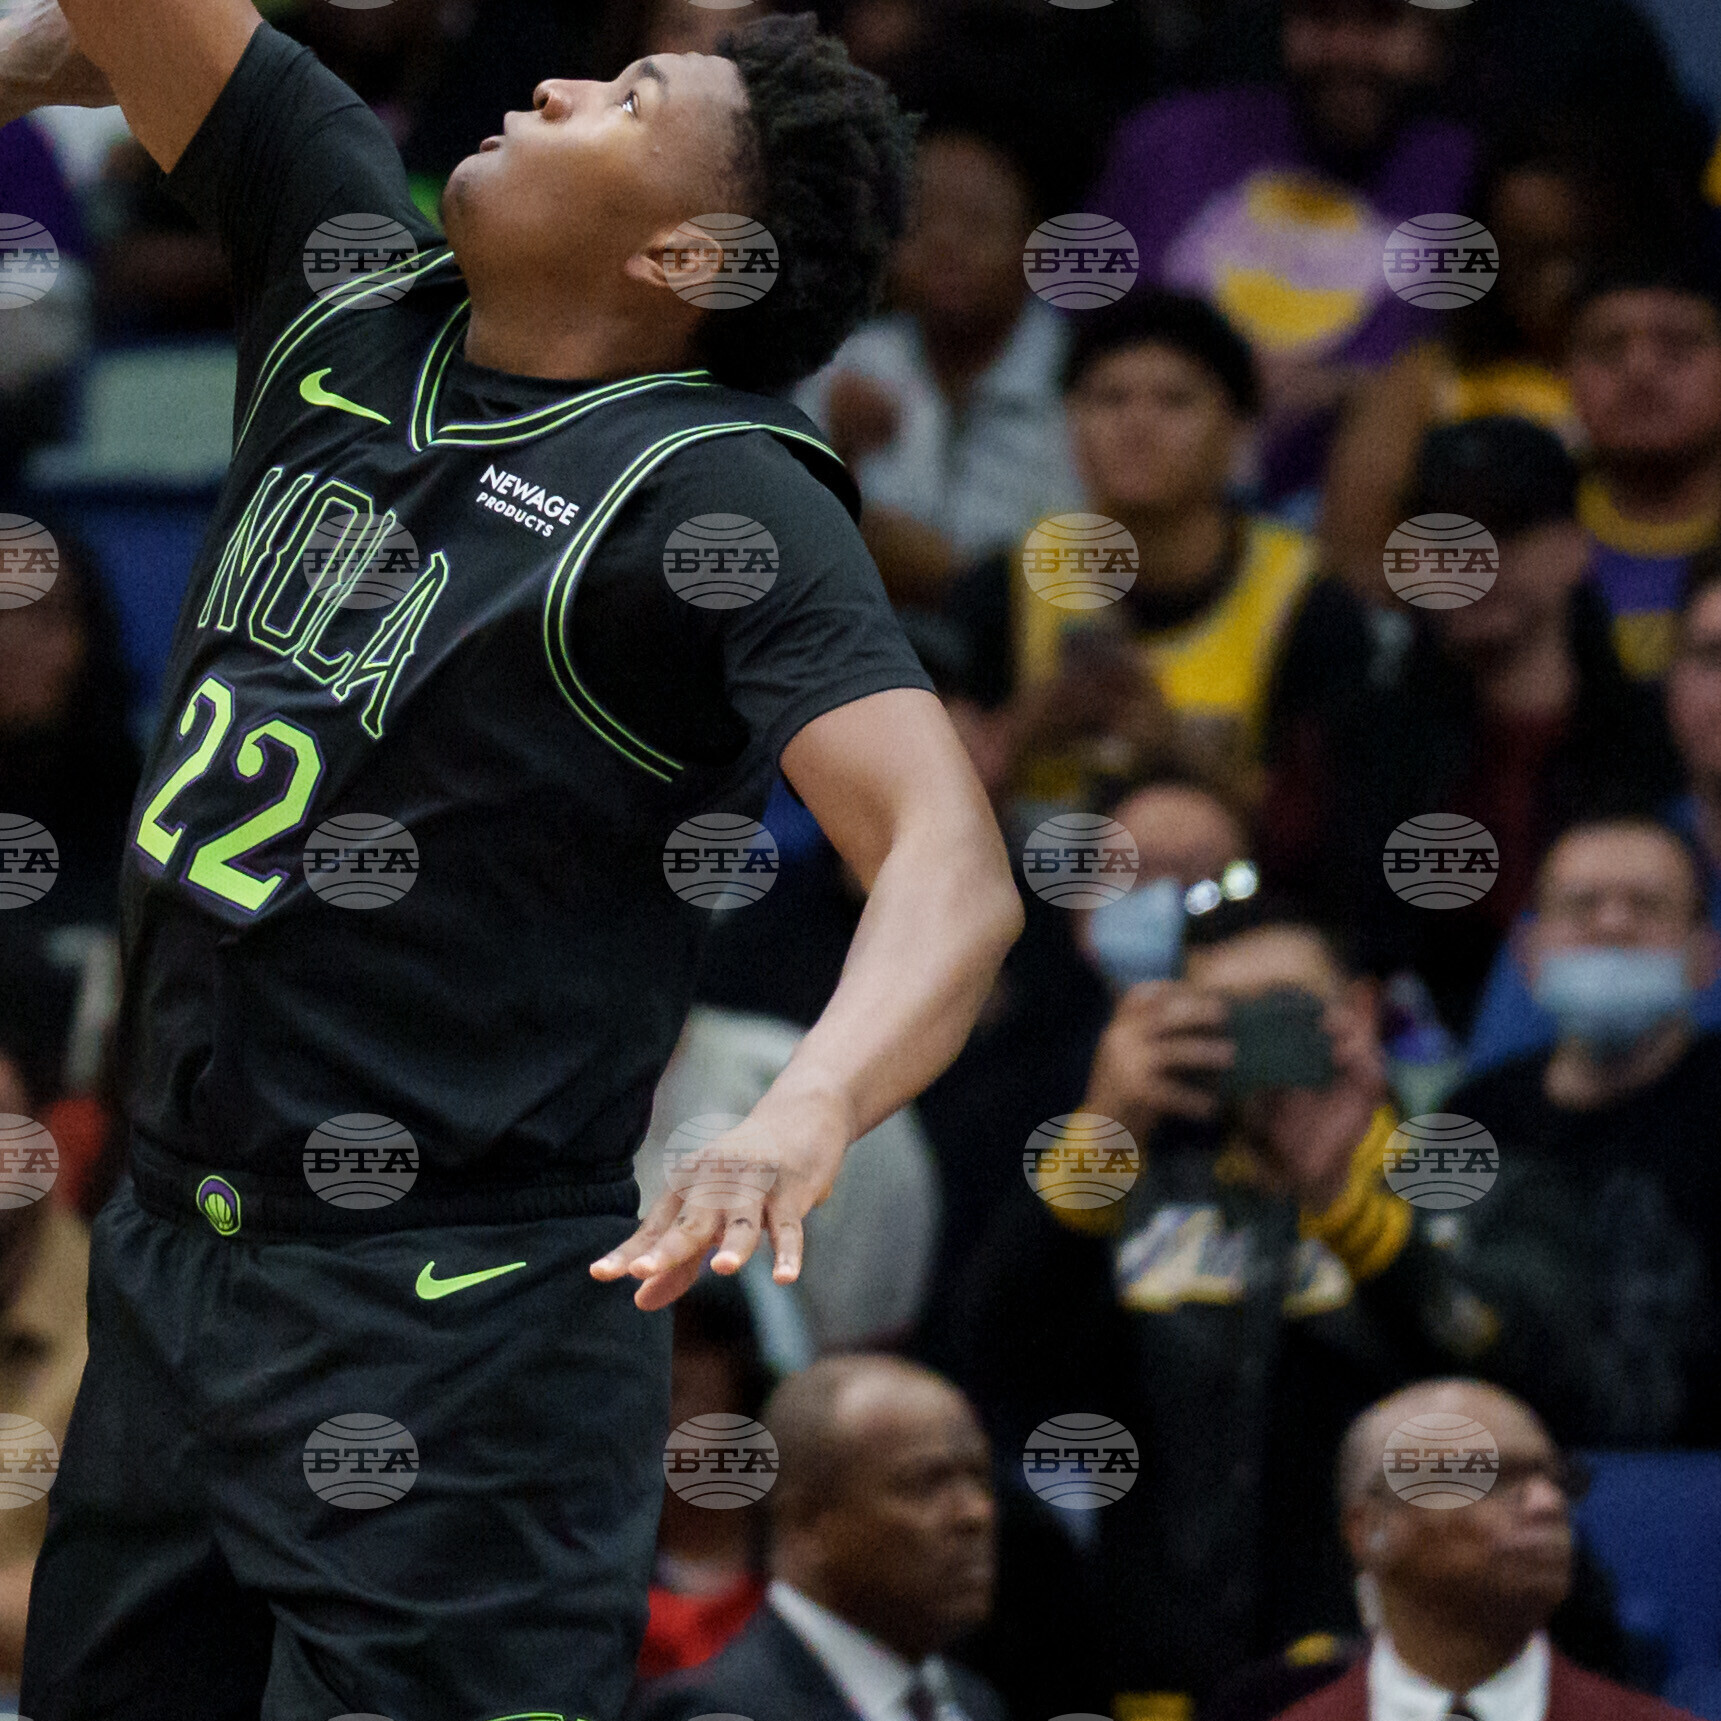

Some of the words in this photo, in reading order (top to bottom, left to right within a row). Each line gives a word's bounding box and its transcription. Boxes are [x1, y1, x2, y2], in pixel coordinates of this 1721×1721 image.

[476, 491, 554, 537] PRODUCTS
[480, 464, 579, 525] NEWAGE
[198, 467, 449, 739] NOLA
[134, 673, 326, 913] 22
